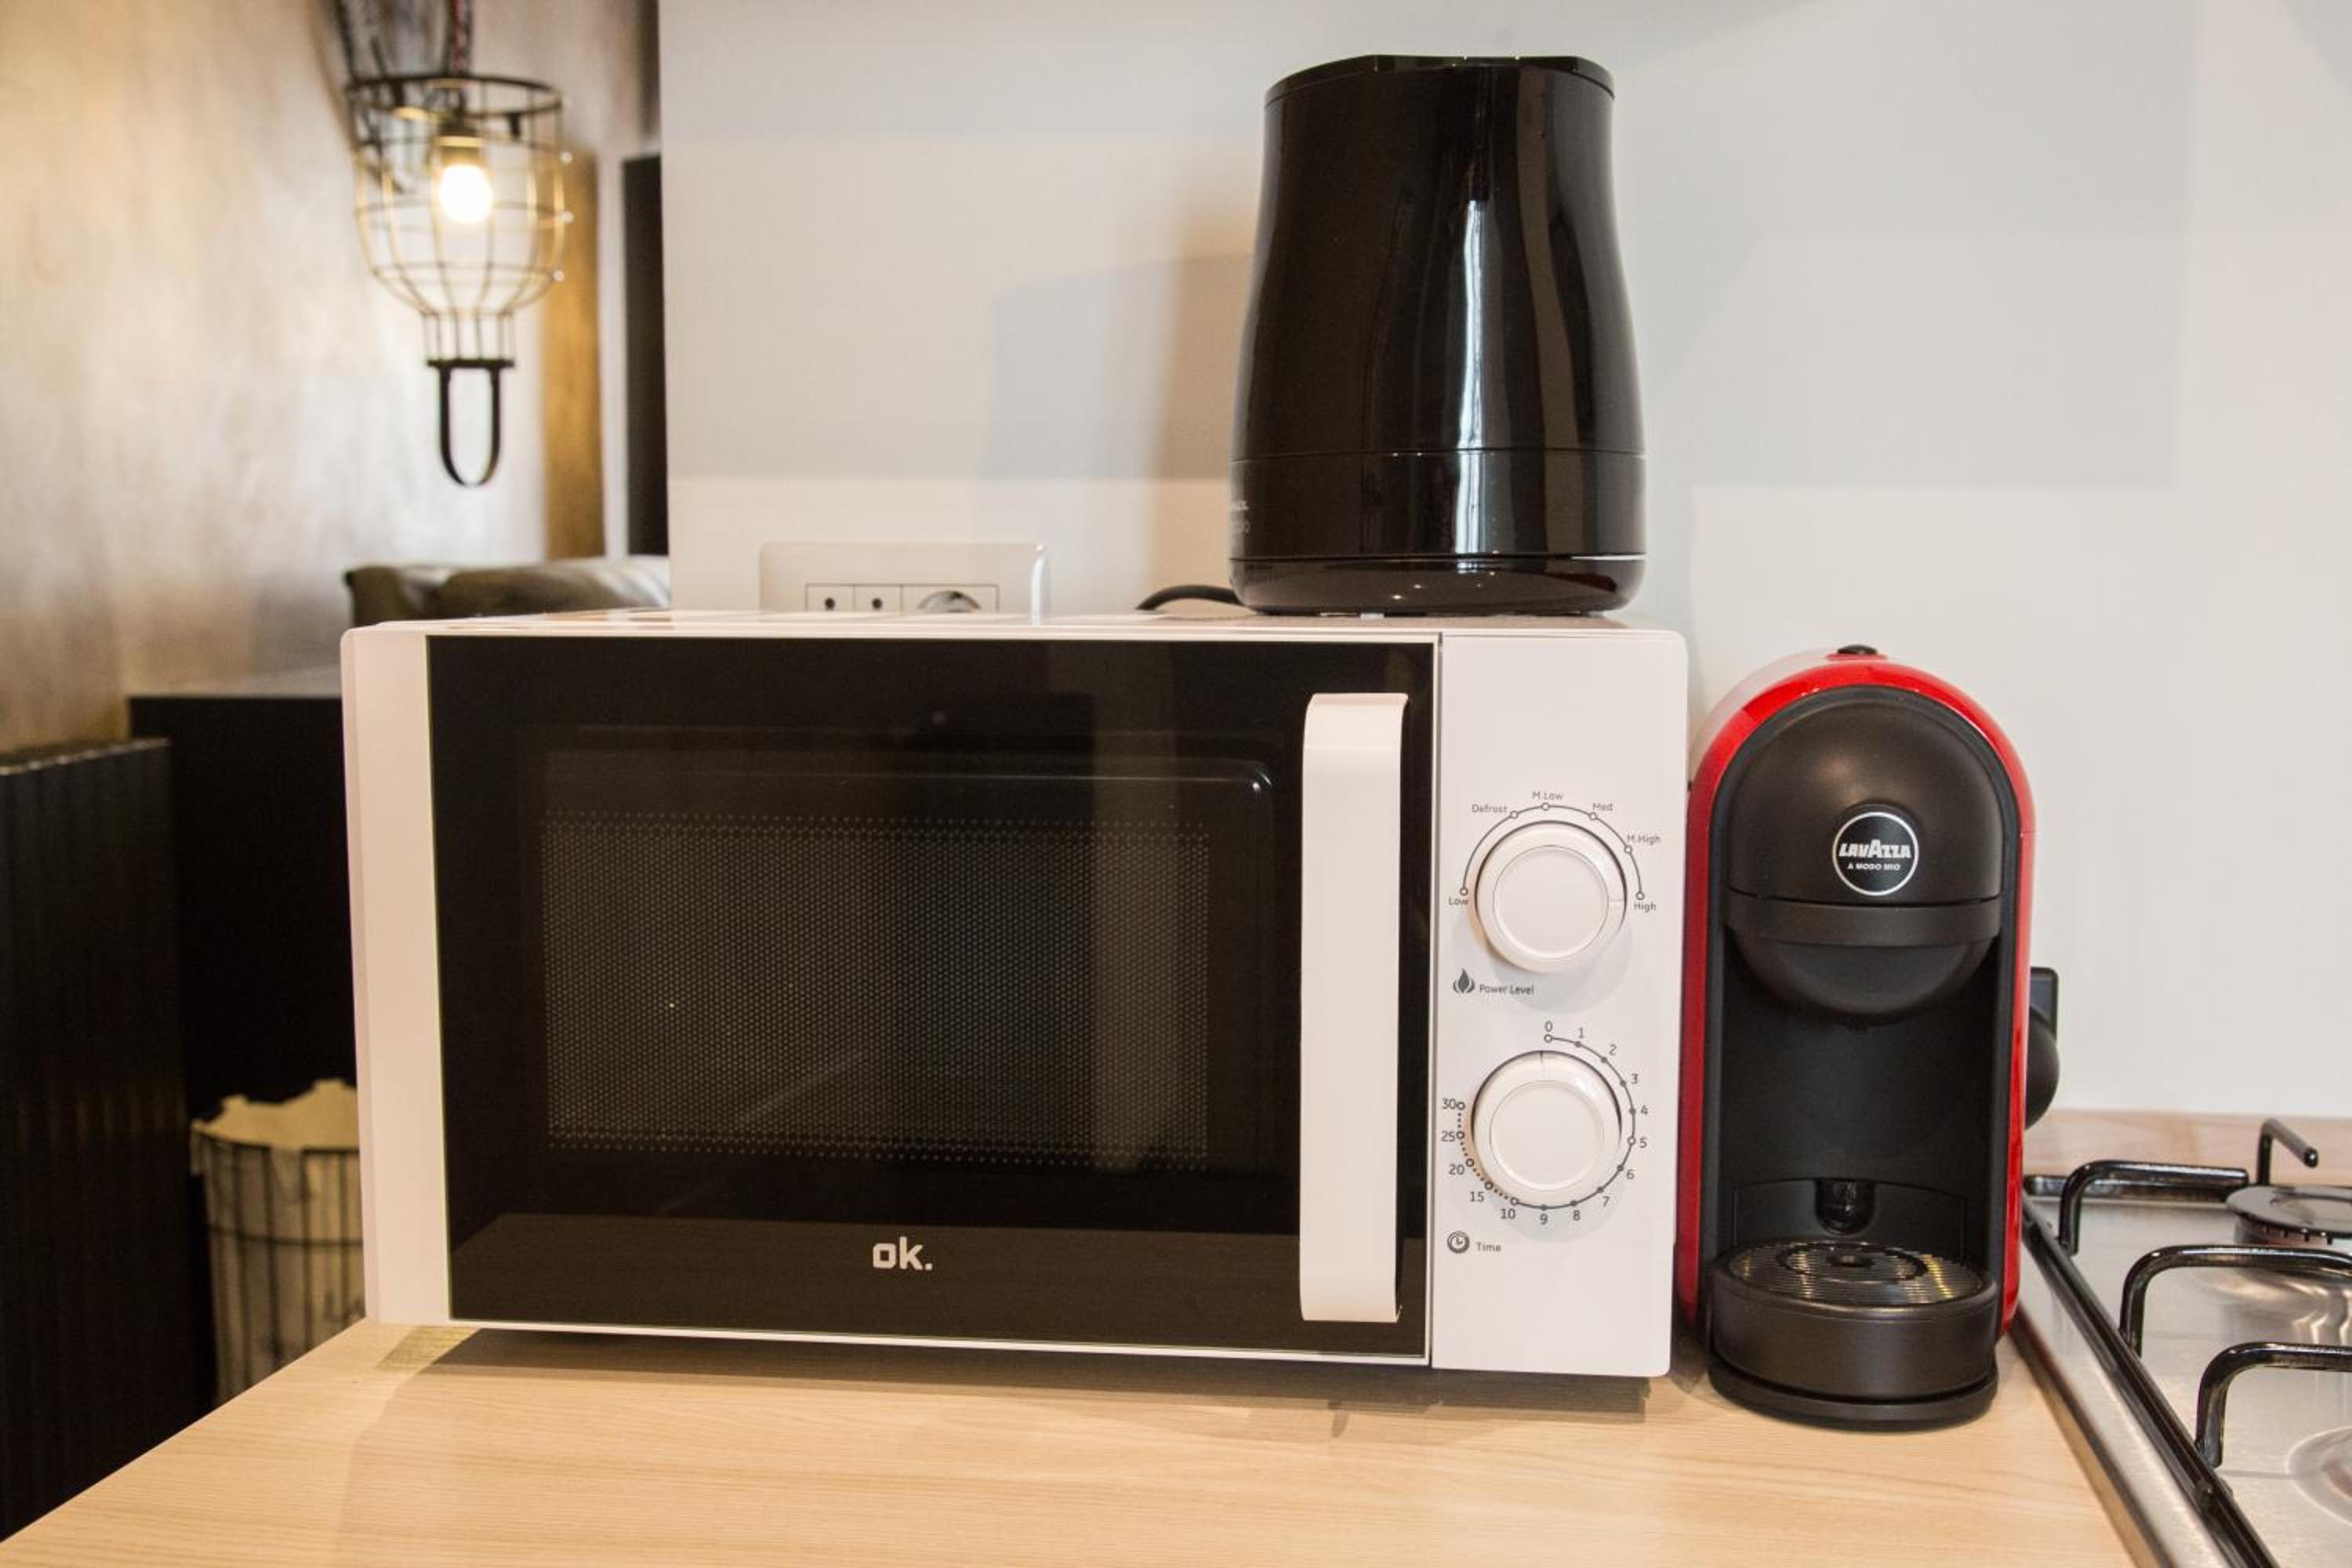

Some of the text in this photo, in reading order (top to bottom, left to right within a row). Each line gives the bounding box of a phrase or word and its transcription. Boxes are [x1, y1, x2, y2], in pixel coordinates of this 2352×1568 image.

[1592, 802, 1613, 811] Med
[1838, 839, 1911, 858] LAVAZZA
[1448, 896, 1468, 906] Low
[1634, 902, 1657, 912] High
[1479, 984, 1534, 995] Power Level
[1544, 1021, 1553, 1033] 0
[1577, 1028, 1585, 1040] 1
[1609, 1044, 1617, 1056] 2
[1632, 1074, 1639, 1085] 3
[1442, 1099, 1456, 1110] 30
[1639, 1105, 1649, 1116] 4
[1442, 1131, 1456, 1142] 25
[1640, 1138, 1647, 1149] 5
[1449, 1164, 1465, 1175] 20
[1627, 1170, 1635, 1180] 6
[1470, 1192, 1484, 1203] 15
[1603, 1196, 1610, 1207] 7
[1501, 1208, 1516, 1220] 10
[1540, 1214, 1548, 1225] 9
[1573, 1210, 1581, 1221] 8
[872, 1236, 934, 1271] ok.
[1475, 1243, 1501, 1253] Time
